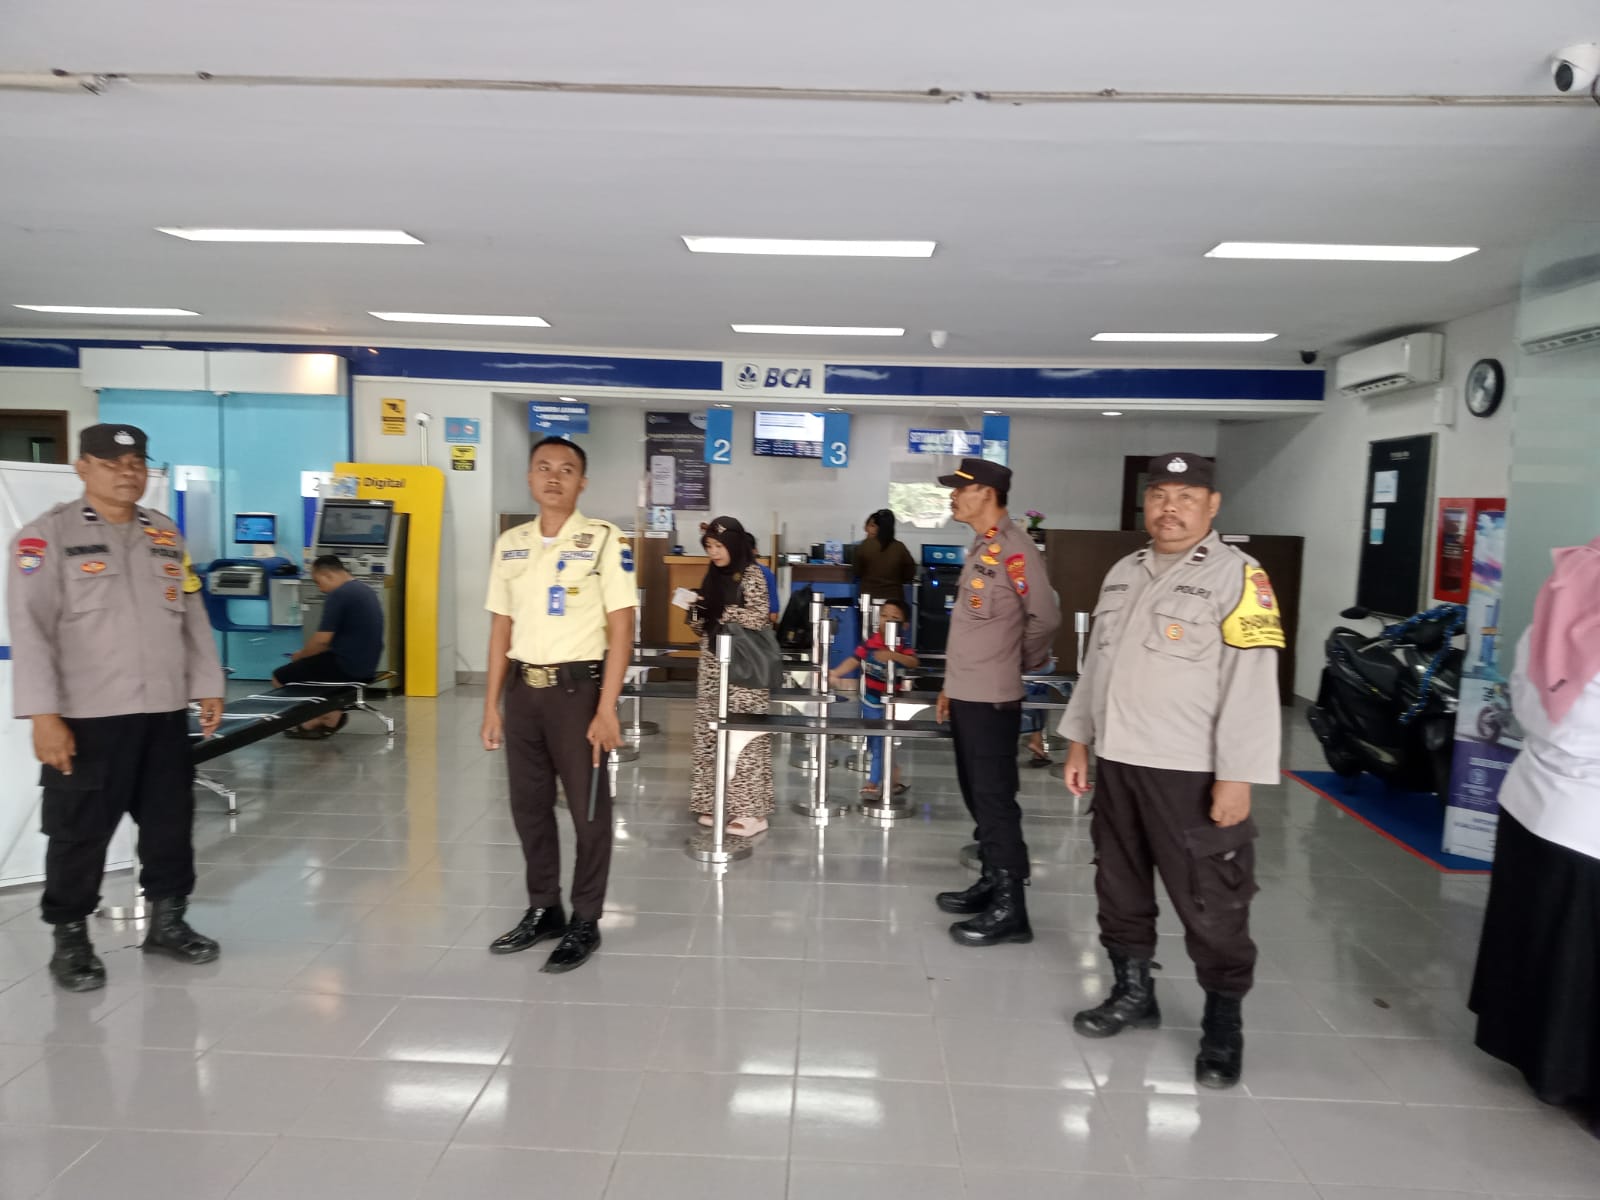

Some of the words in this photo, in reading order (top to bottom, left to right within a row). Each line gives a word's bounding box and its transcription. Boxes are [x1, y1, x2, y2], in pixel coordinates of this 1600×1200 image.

[764, 368, 812, 388] BCA
[713, 439, 730, 461] 2
[830, 442, 847, 464] 3
[363, 477, 406, 489] Digital
[1173, 585, 1213, 599] POLRI
